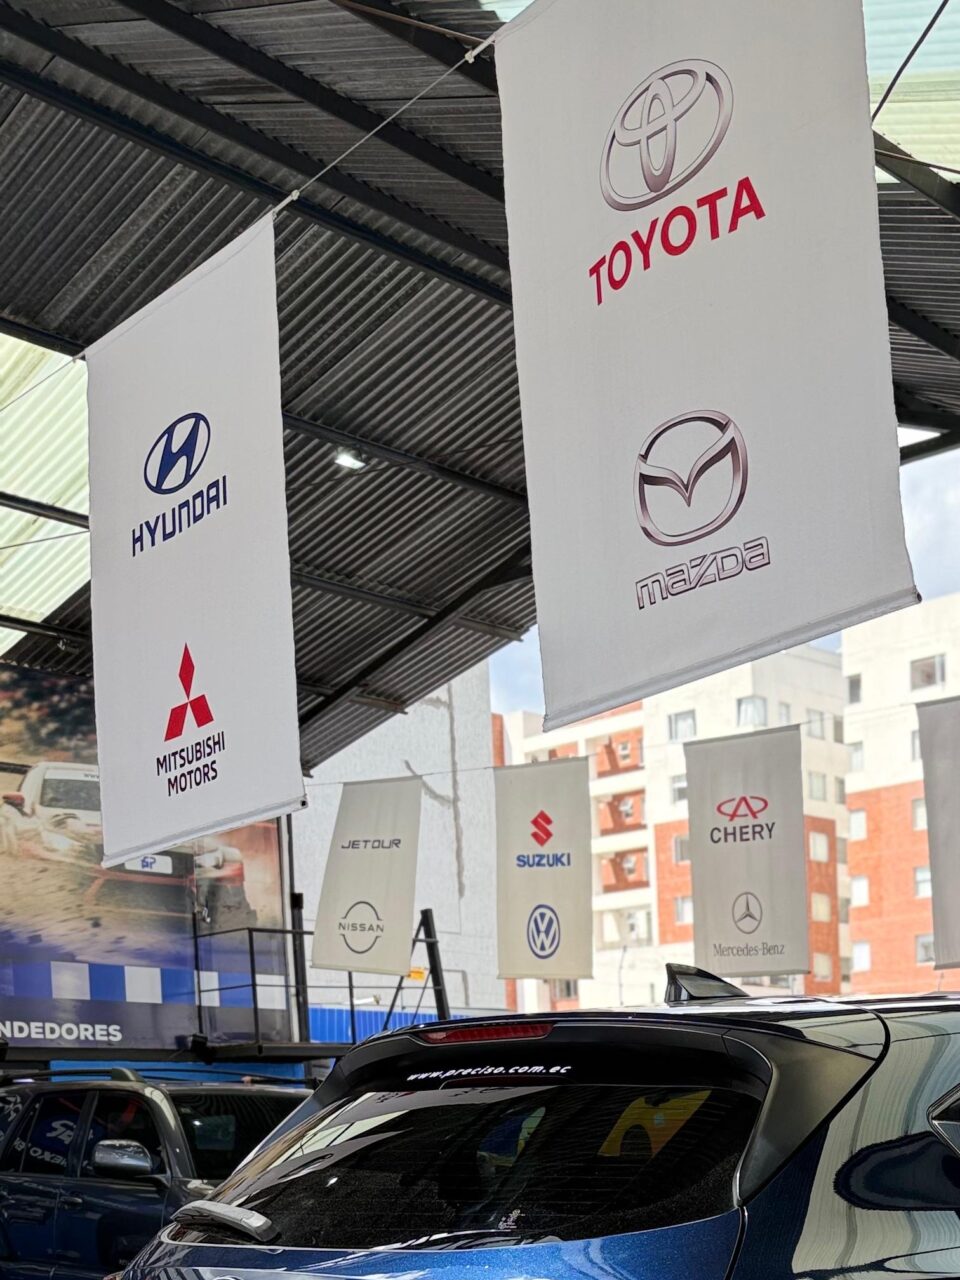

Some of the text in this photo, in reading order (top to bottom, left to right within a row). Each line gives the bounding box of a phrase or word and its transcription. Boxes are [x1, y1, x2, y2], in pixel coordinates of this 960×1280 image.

[588, 176, 766, 306] TOYOTA
[131, 474, 228, 557] HYUNDAI
[156, 731, 226, 776] MITSUBISHI
[167, 760, 218, 796] MOTORS
[710, 822, 775, 844] CHERY
[341, 837, 402, 850] JETOUR
[516, 852, 571, 868] SUZUKI
[338, 922, 384, 934] NISSAN
[713, 943, 785, 957] Mercedes-Benz
[406, 1065, 571, 1081] www.preciso.com.ec
